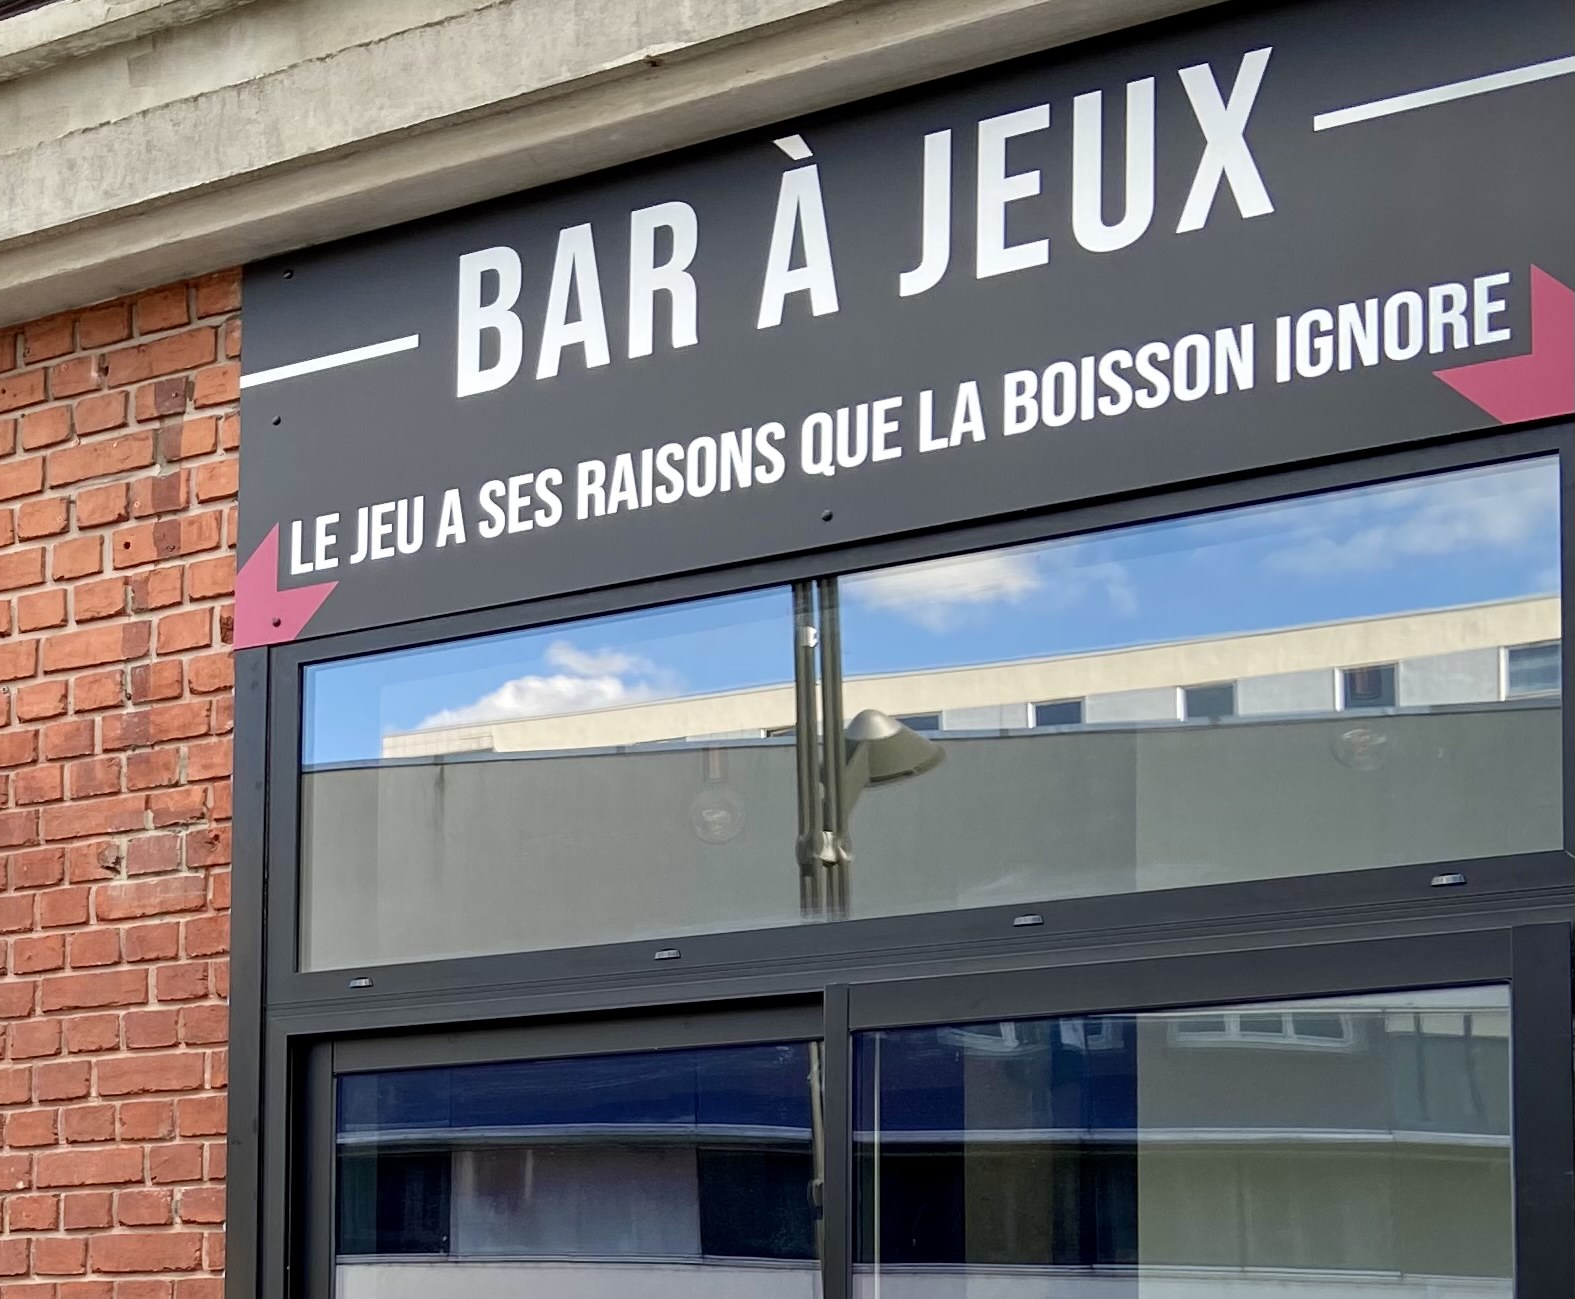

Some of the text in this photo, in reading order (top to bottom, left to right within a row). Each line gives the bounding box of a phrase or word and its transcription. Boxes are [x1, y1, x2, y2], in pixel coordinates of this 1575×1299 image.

[455, 46, 1275, 399] BAR À JEUX
[289, 271, 1511, 576] LE JEU A SES RAISONS QUE LA BOISSON IGNORE
